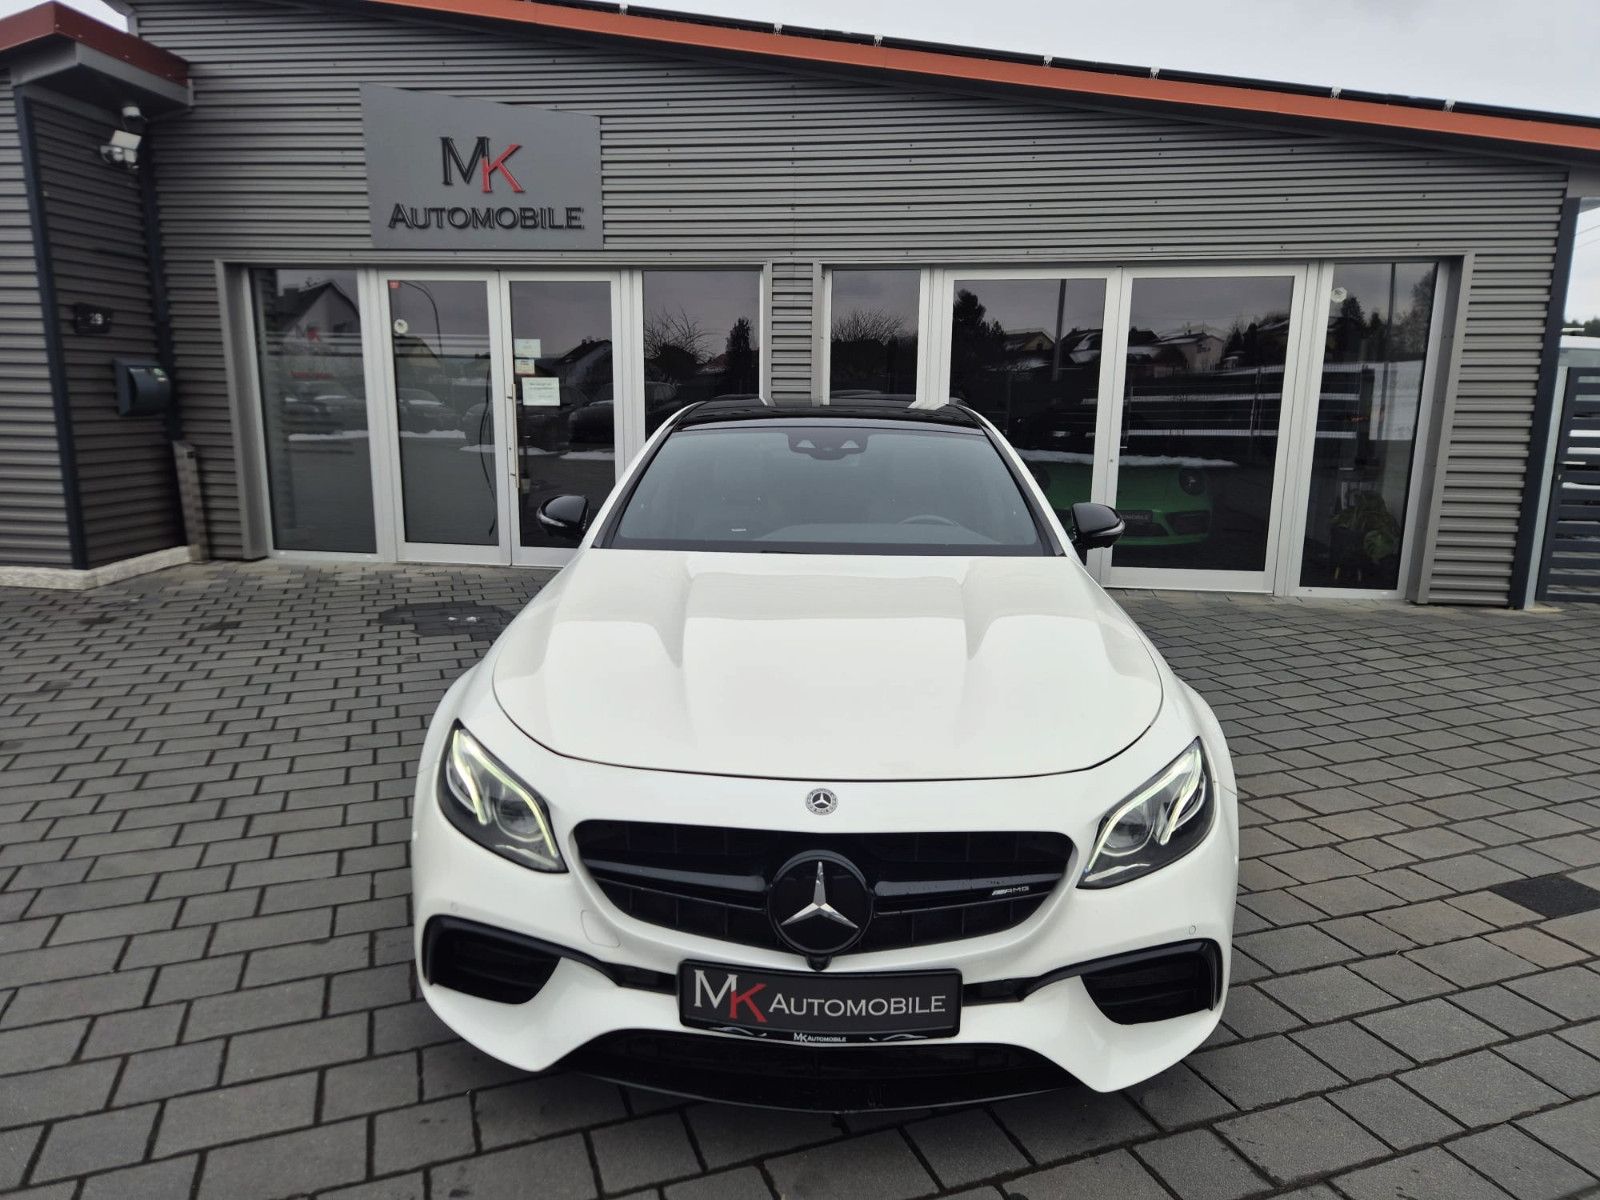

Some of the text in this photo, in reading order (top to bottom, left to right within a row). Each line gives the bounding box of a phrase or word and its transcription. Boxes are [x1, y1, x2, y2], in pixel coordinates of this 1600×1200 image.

[440, 136, 525, 193] MK
[387, 203, 585, 230] AUTOMOBILE
[1003, 885, 1030, 894] AMG
[694, 969, 946, 1023] MK AUTOMOBILE
[793, 1032, 808, 1043] MK
